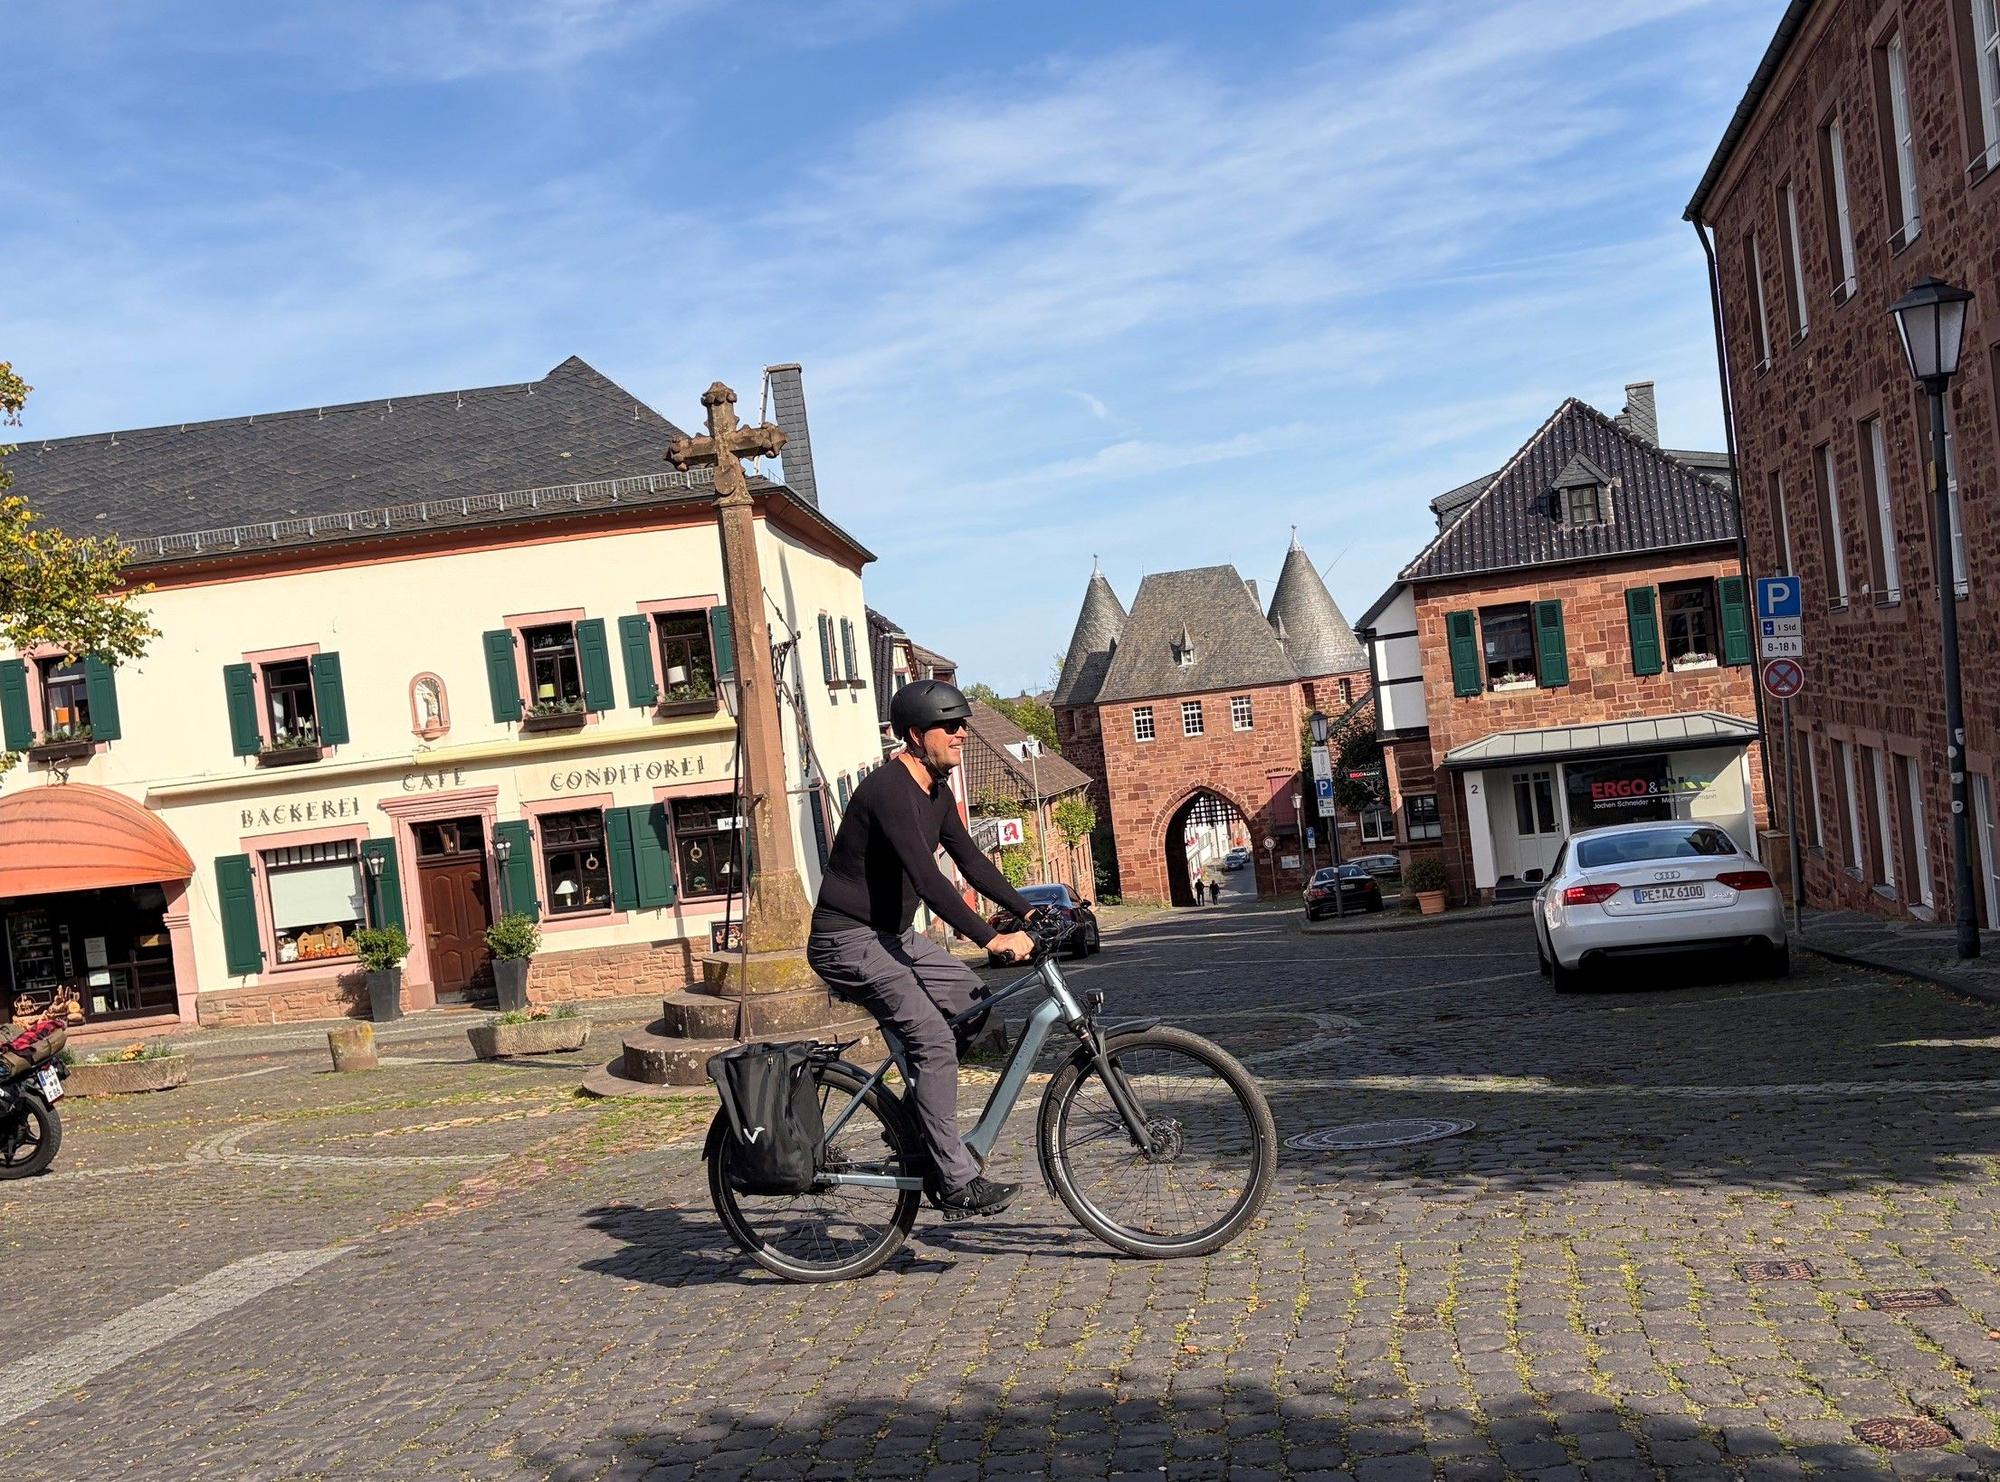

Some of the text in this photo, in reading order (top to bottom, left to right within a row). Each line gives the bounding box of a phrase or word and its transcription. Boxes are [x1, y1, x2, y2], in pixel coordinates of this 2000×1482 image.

[1767, 583, 1790, 614] P
[1783, 623, 1797, 631] Std
[1767, 642, 1797, 652] 8-18 h
[550, 755, 704, 792] CONDITOREI
[1319, 781, 1328, 796] P
[1471, 784, 1479, 794] 2
[1591, 778, 1646, 798] ERGO
[1648, 781, 1658, 793] &
[1593, 801, 1616, 810] Jochen
[1617, 799, 1649, 808] Schneider
[1642, 889, 1655, 901] PE
[1662, 888, 1676, 900] AZ
[1677, 885, 1703, 897] 6100
